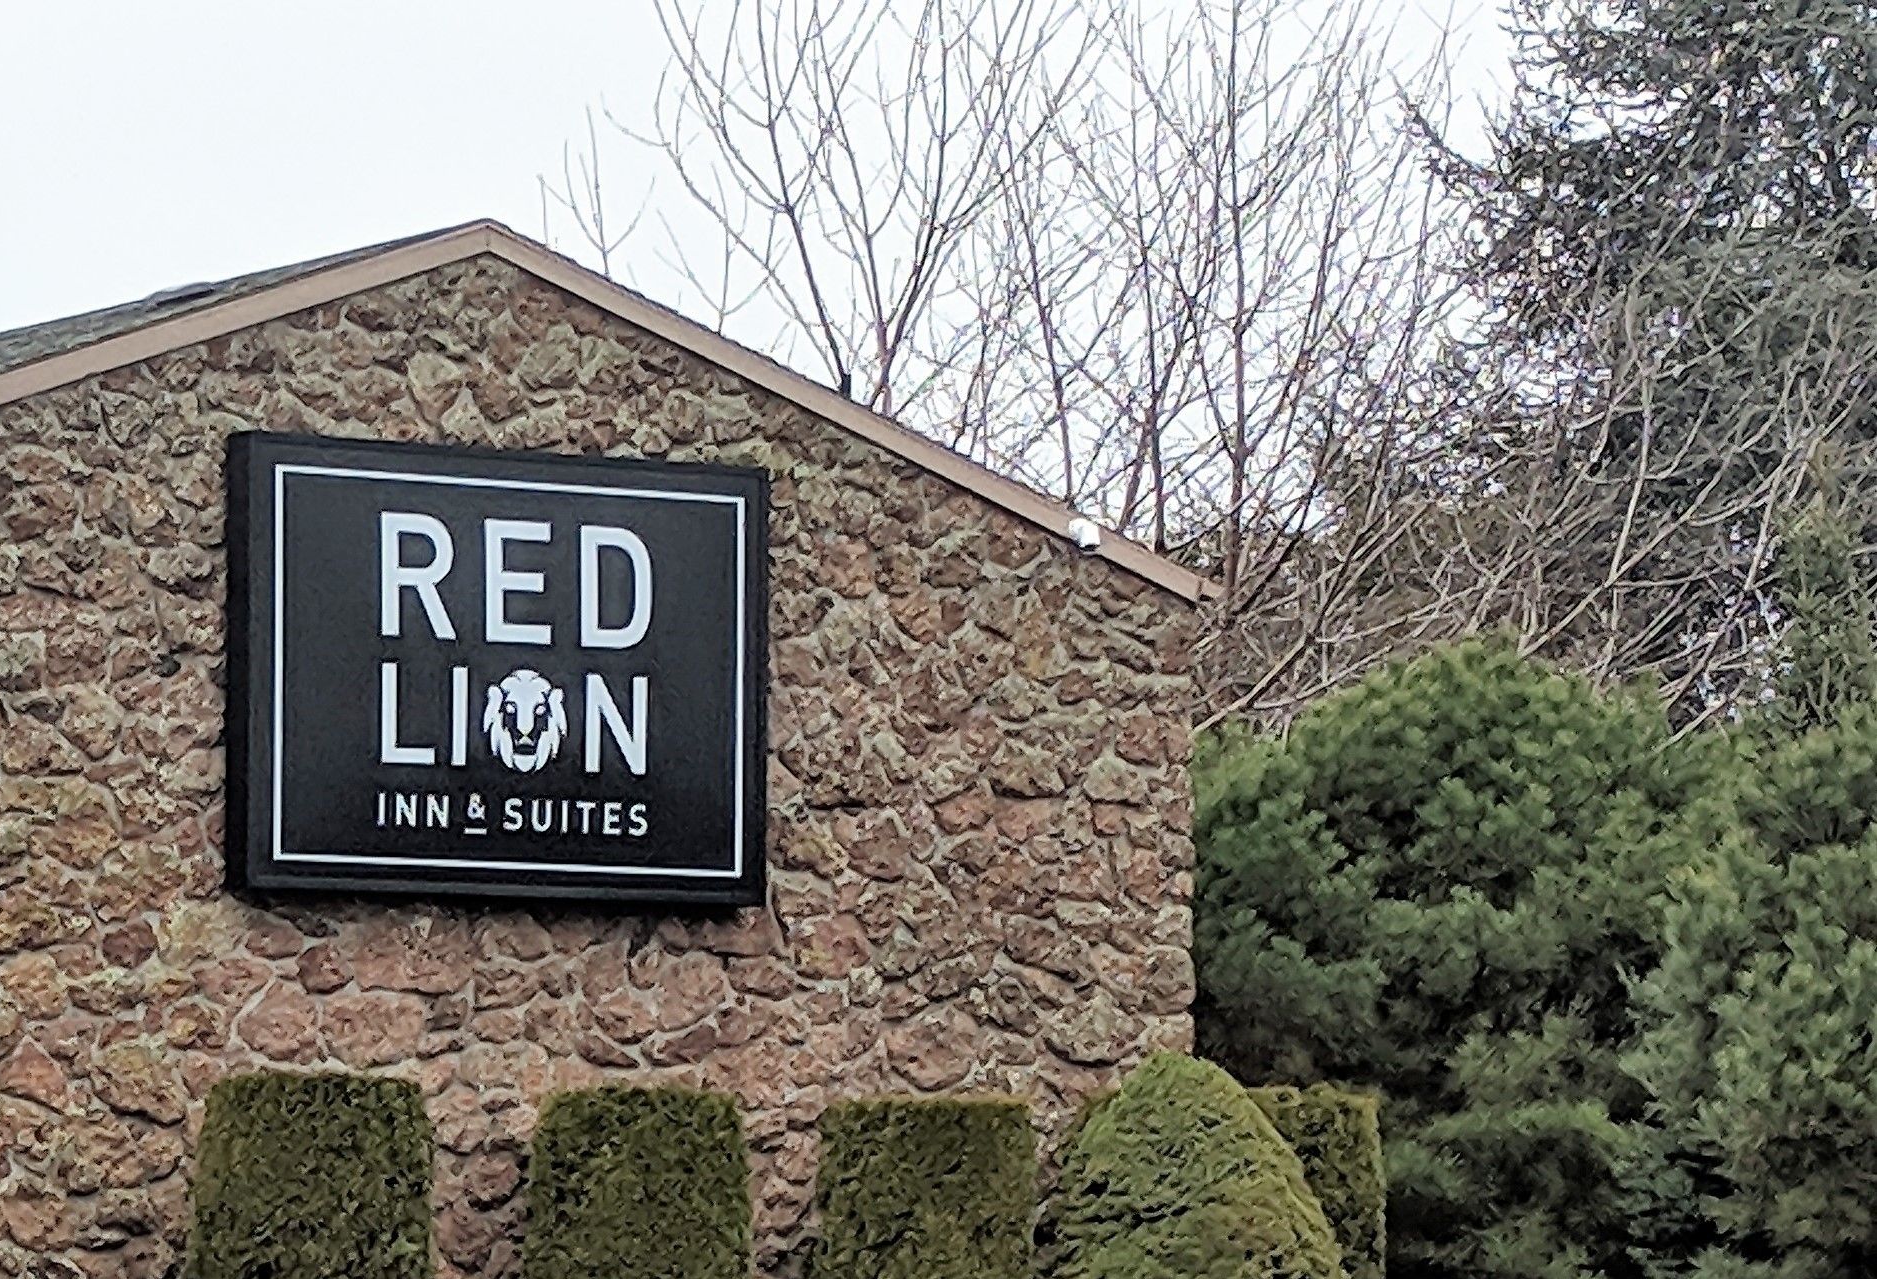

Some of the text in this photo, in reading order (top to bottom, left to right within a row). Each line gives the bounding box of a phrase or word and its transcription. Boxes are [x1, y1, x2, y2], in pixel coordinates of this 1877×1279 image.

[379, 510, 654, 650] RED
[380, 662, 649, 775] LIN
[376, 791, 649, 837] INN & SUITES
